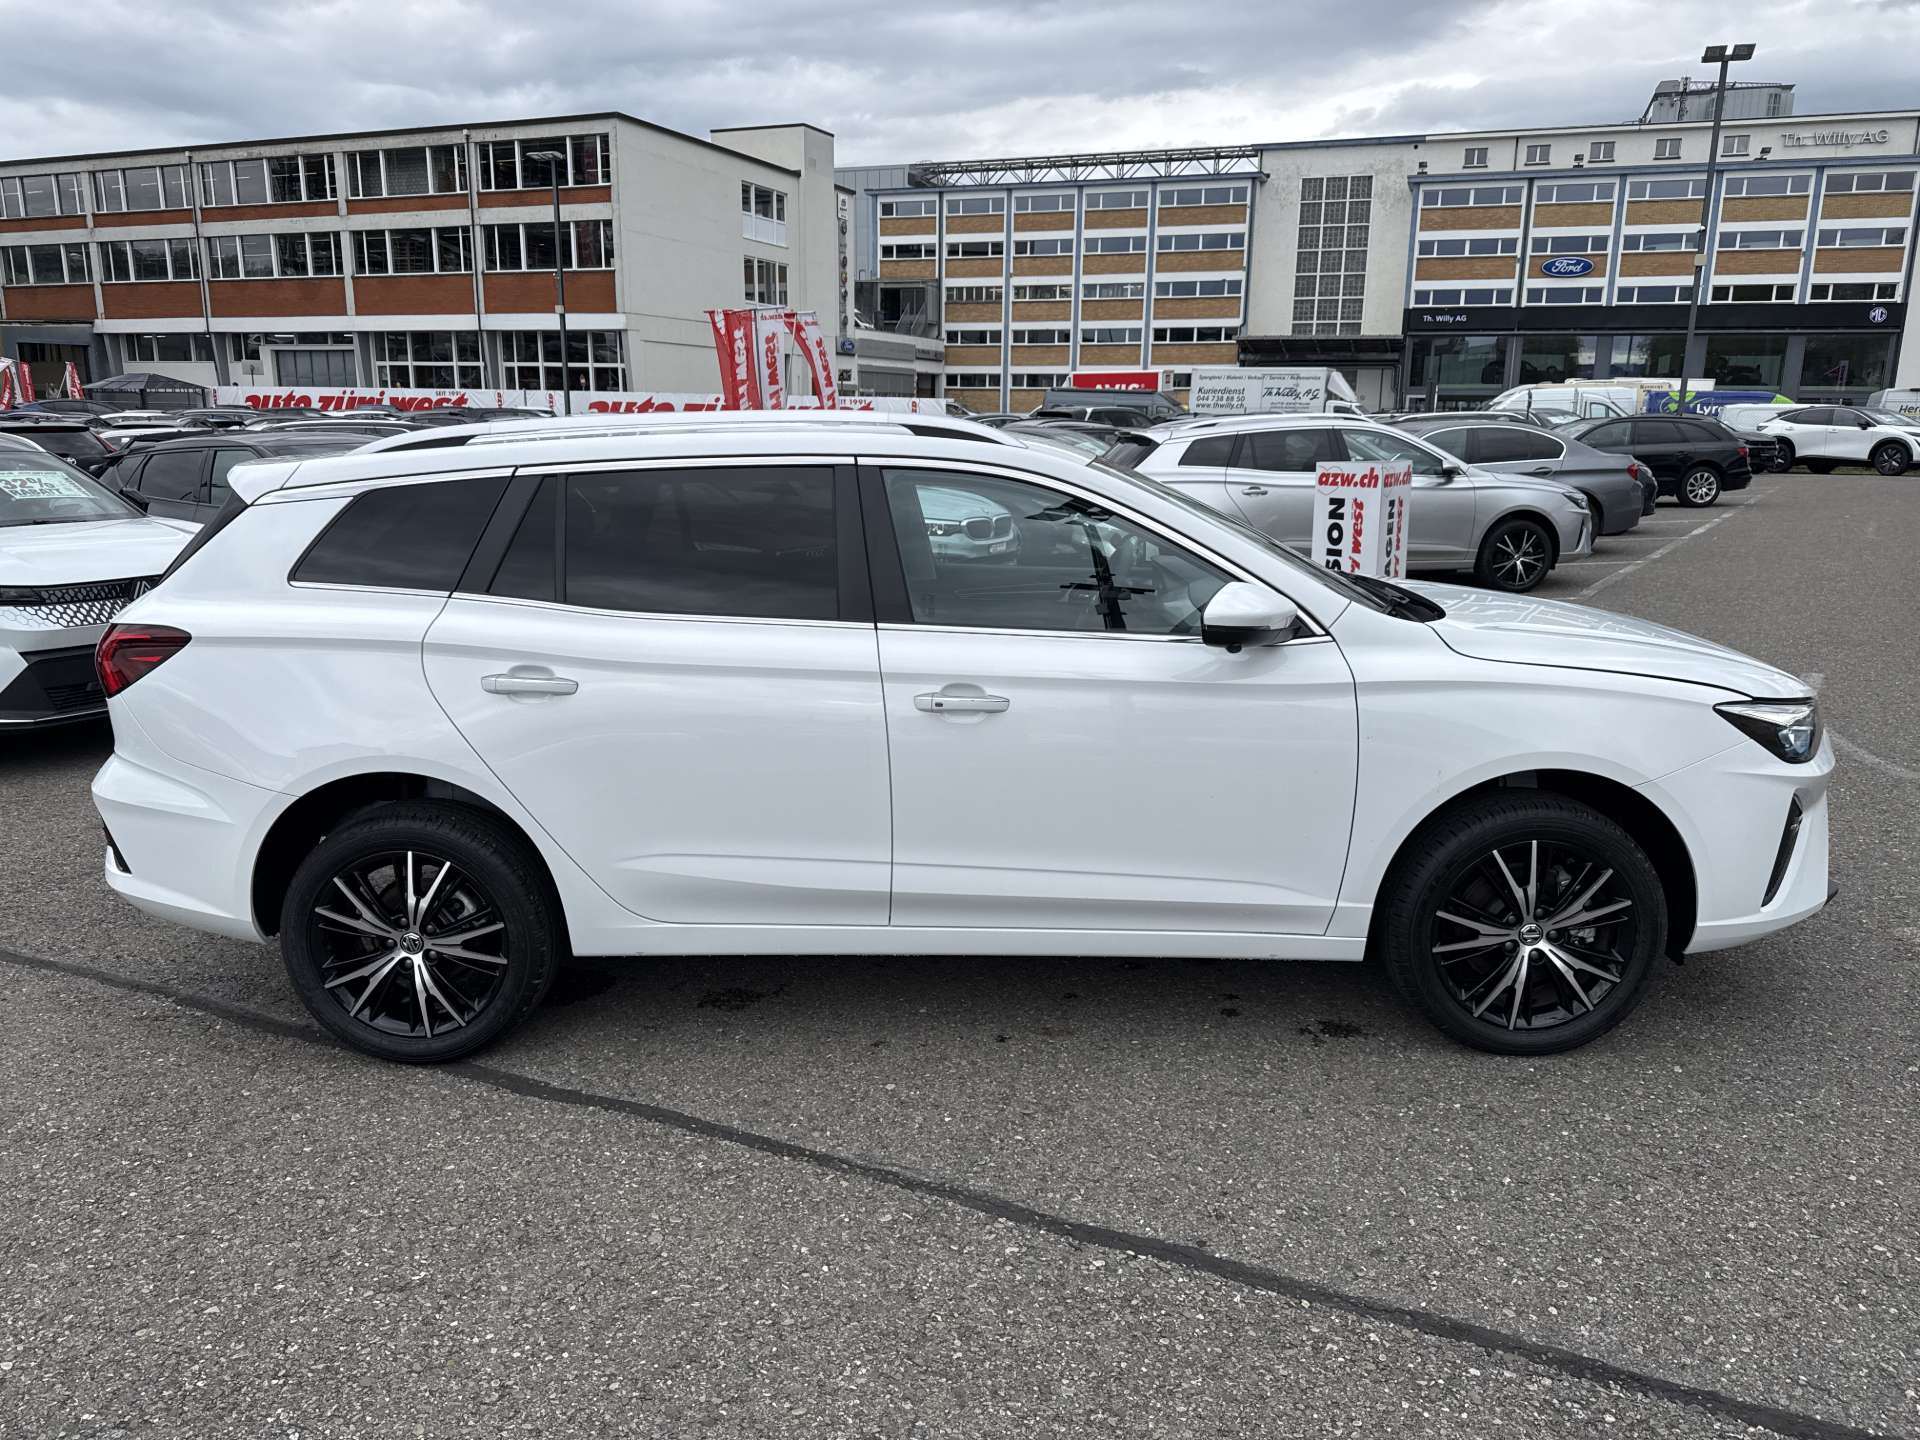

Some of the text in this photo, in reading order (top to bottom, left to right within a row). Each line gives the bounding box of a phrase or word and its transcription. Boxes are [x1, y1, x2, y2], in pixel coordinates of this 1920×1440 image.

[1815, 130, 1855, 148] Willy
[1861, 129, 1889, 143] AG
[1551, 258, 1584, 273] Ford
[1435, 315, 1454, 323] Willy
[1197, 386, 1246, 395] Kurierdienst
[245, 389, 468, 411] auto züri west
[1899, 404, 1920, 413] Her
[1696, 403, 1720, 416] Lyr
[1318, 467, 1379, 488] azw.ch
[1384, 464, 1412, 488] azw.ch
[1351, 497, 1364, 554] west
